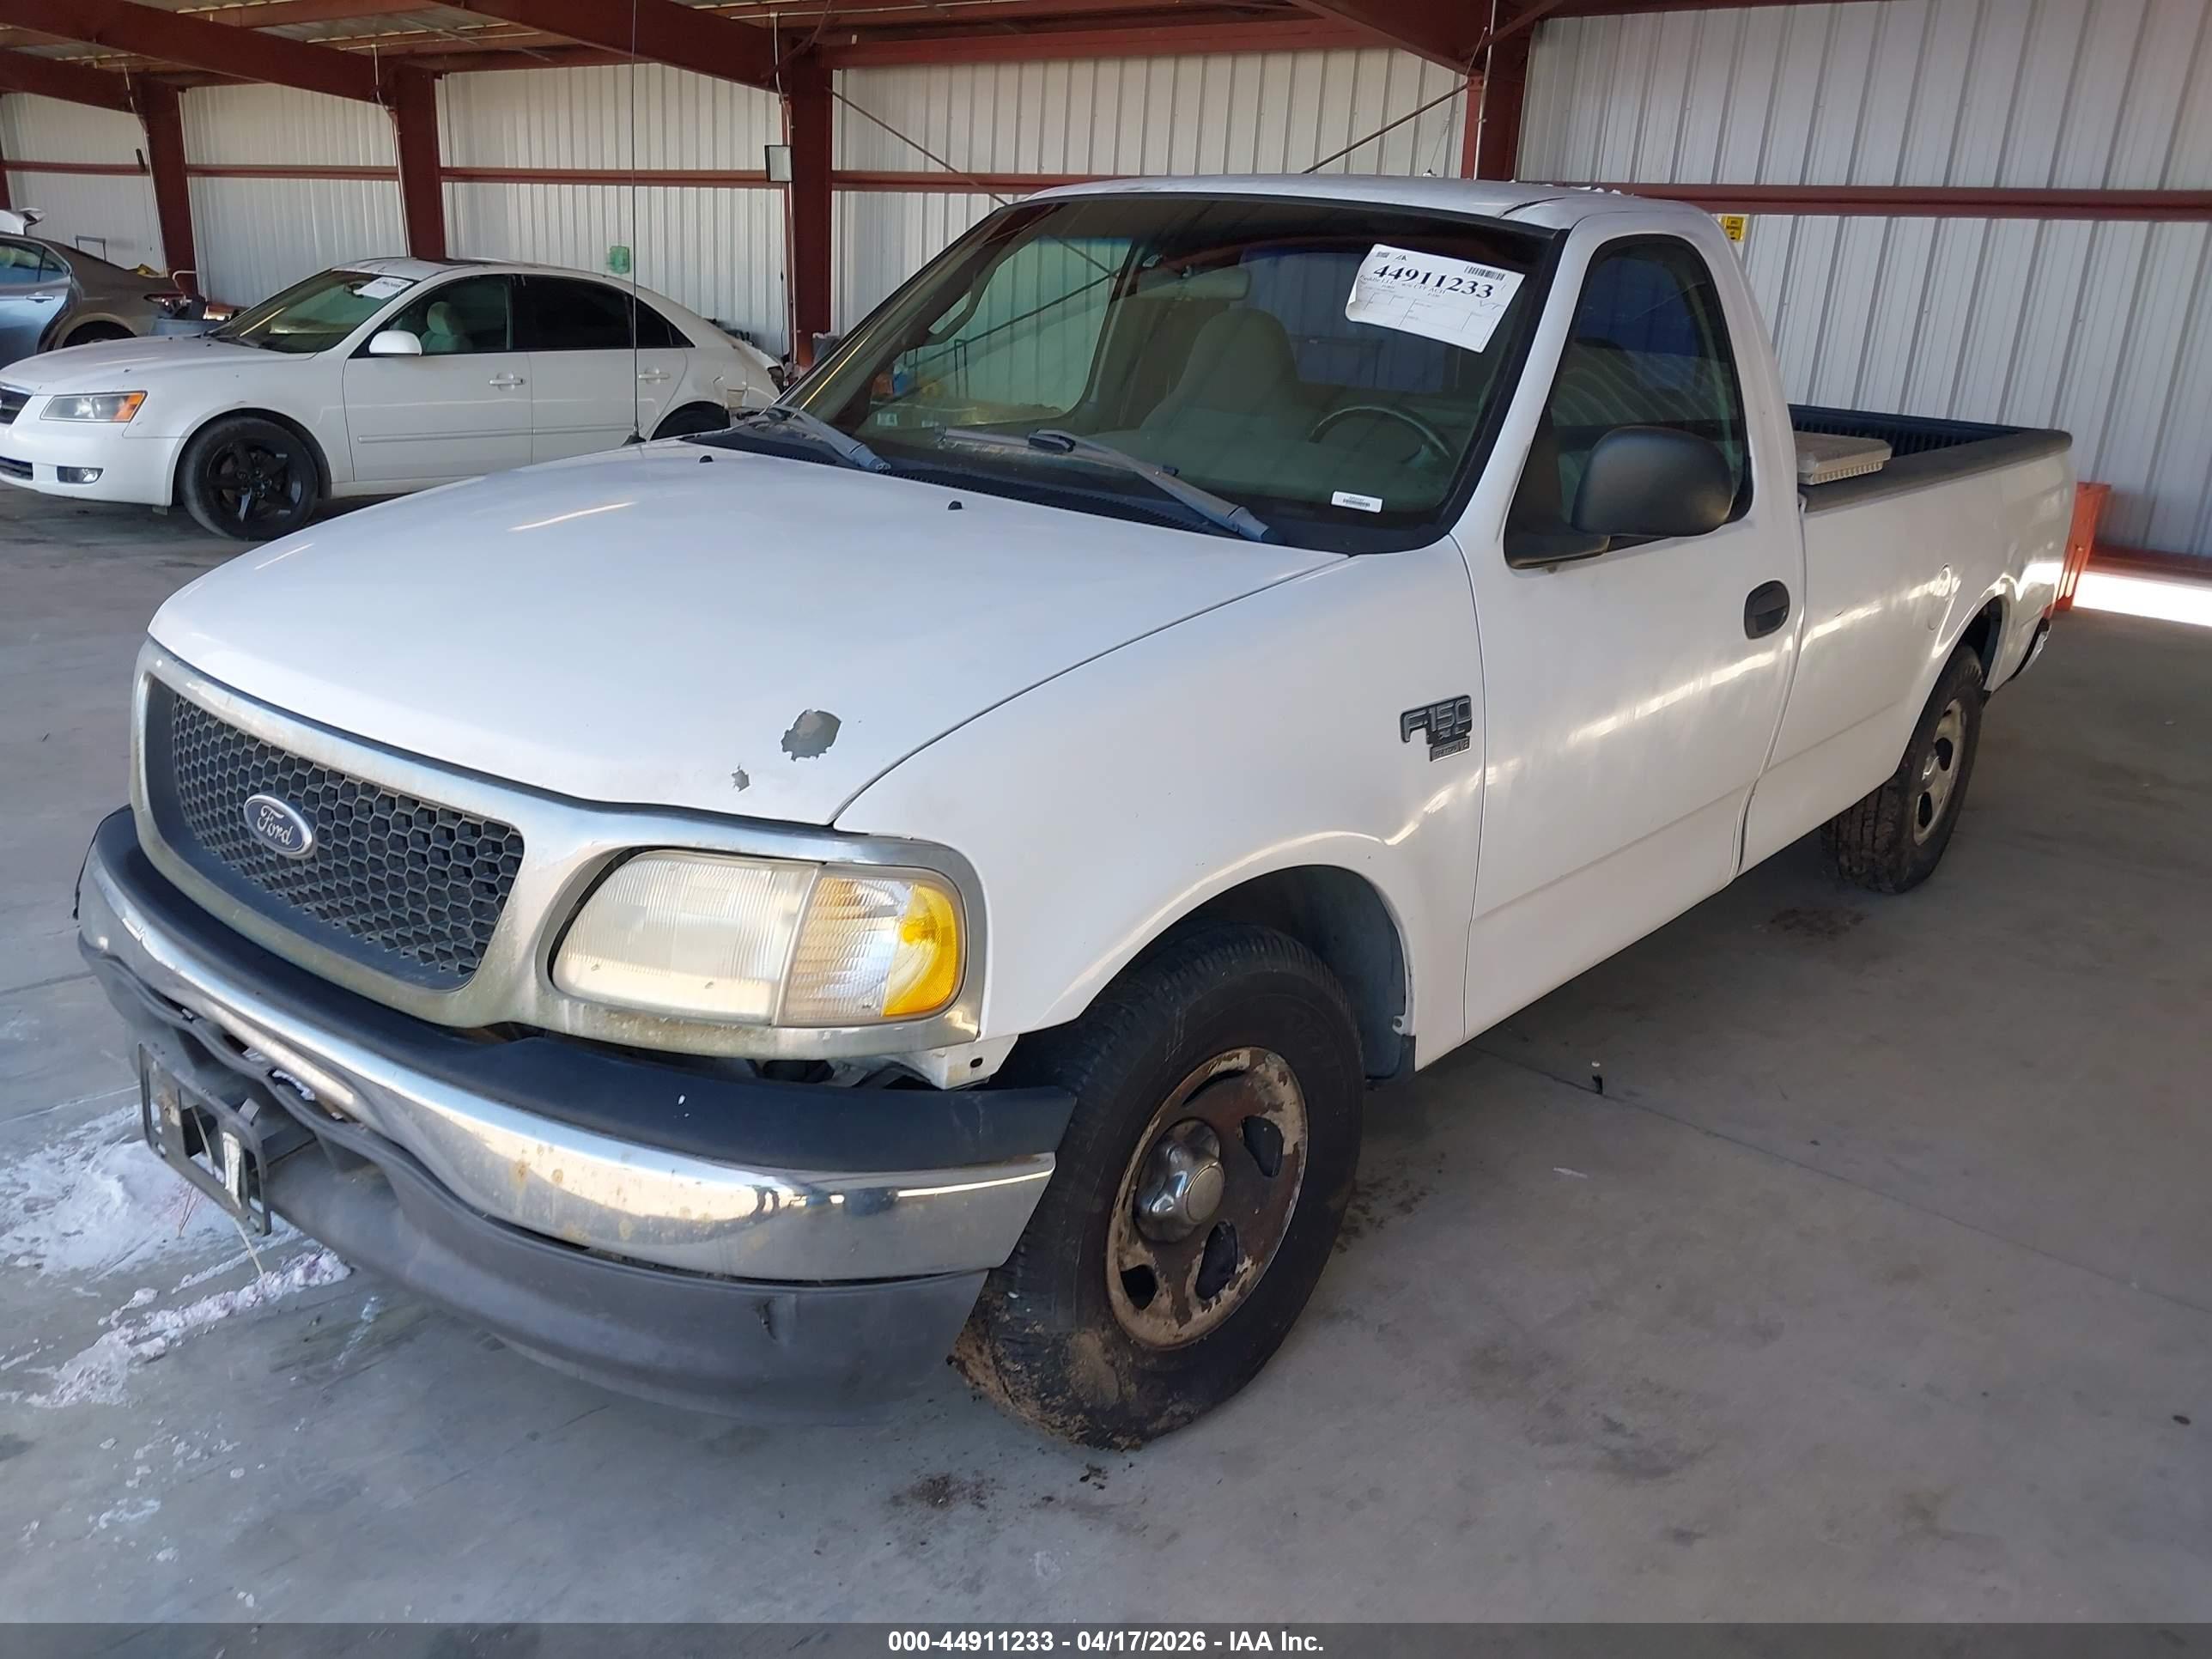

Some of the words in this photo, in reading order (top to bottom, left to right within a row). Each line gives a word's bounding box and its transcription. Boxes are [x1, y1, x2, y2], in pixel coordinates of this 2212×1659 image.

[1373, 264, 1494, 299] 44911233
[1401, 696, 1472, 743] F150
[257, 805, 294, 846] Ford
